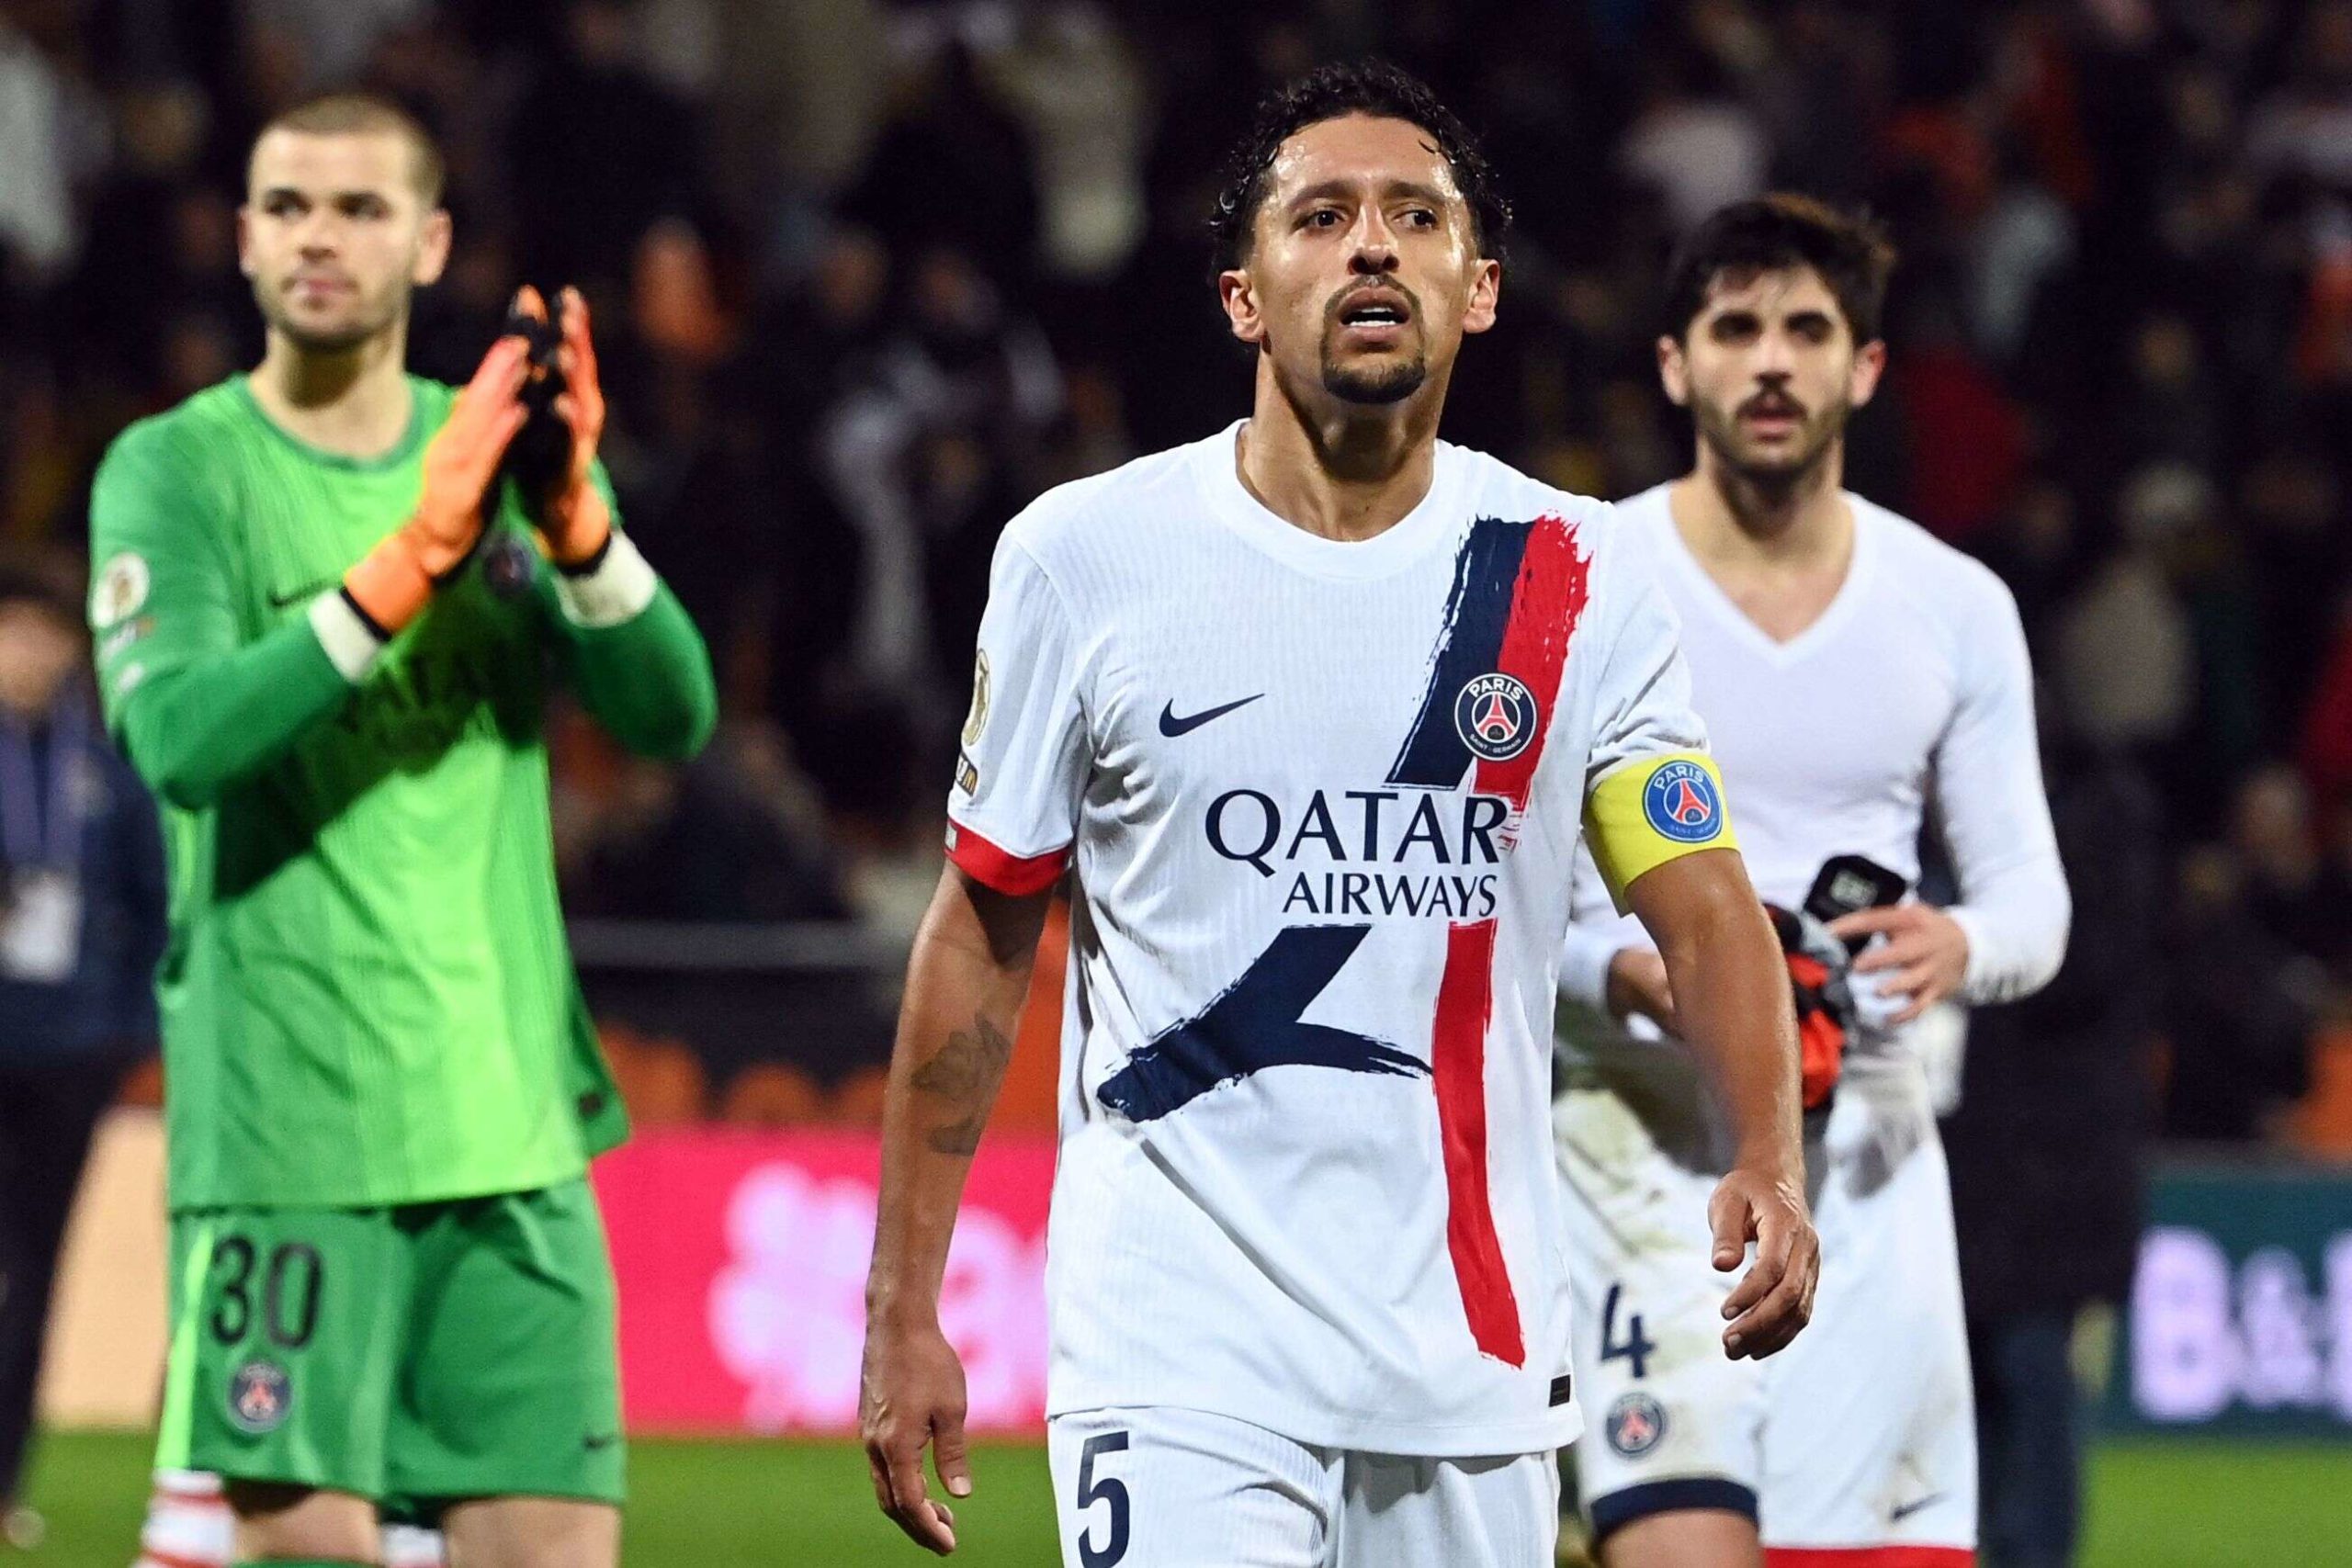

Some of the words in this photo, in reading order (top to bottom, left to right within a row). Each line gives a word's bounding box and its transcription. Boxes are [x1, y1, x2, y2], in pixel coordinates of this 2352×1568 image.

[1469, 678, 1523, 700] PARIS
[1654, 765, 1704, 790] PARIS
[1204, 789, 1509, 878] QATAR
[1282, 872, 1498, 917] AIRWAYS
[210, 1235, 322, 1349] 30
[1600, 1283, 1656, 1379] 4
[1078, 1430, 1130, 1568] 5
